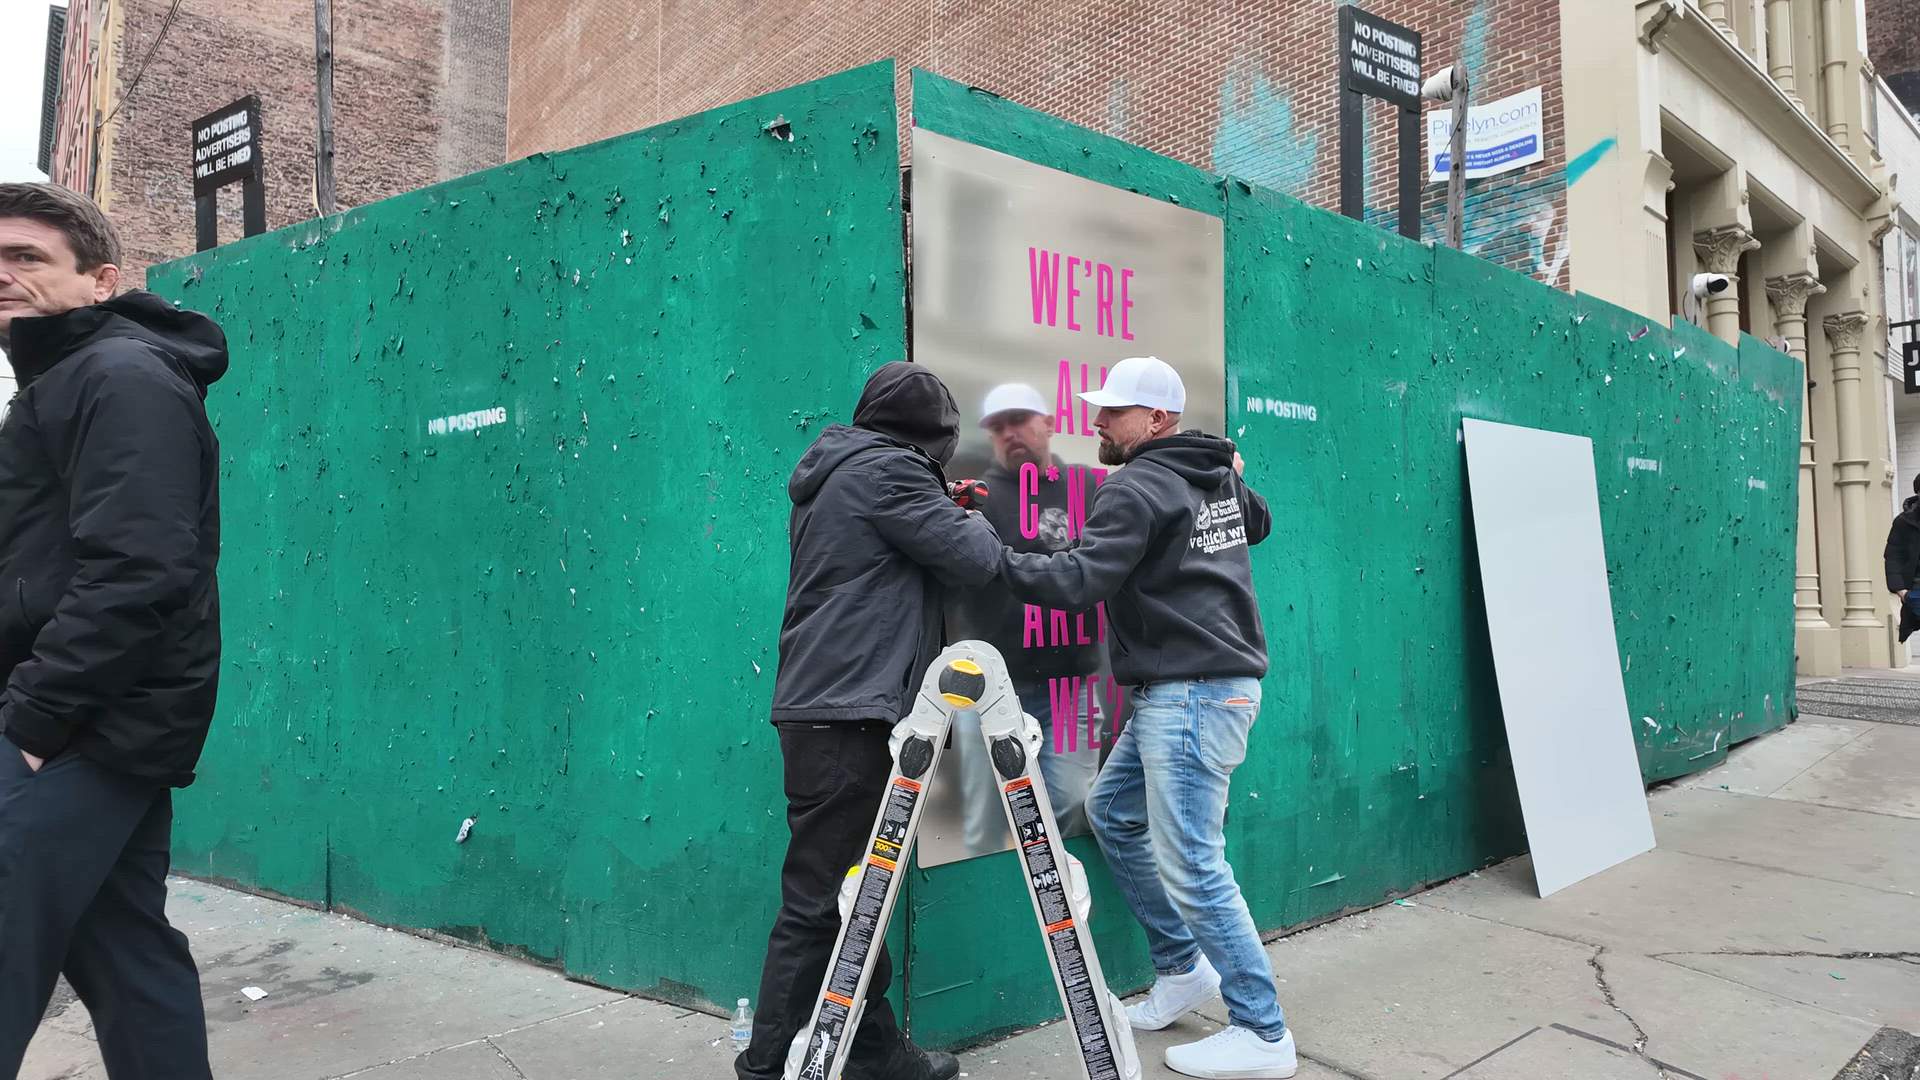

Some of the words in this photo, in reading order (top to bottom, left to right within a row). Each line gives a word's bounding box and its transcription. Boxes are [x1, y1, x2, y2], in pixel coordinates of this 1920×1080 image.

[1354, 21, 1371, 39] NO
[1372, 28, 1417, 58] POSTING
[1351, 38, 1420, 79] ADVERTISERS
[1351, 58, 1376, 79] WILL
[1377, 68, 1390, 86] BE
[1391, 75, 1419, 96] FINED
[198, 127, 211, 143] NO
[211, 110, 248, 138] POSTING
[1433, 102, 1538, 138] Pielyn.com
[195, 126, 251, 162] ADVERTISERS
[196, 162, 215, 179] WILL
[216, 157, 227, 172] BE
[227, 145, 252, 168] FINED
[1028, 247, 1135, 341] WE'RE
[1055, 360, 1109, 437] AL
[1246, 396, 1264, 414] NO
[1265, 398, 1317, 422] POSTING
[428, 418, 447, 435] NO
[447, 406, 507, 433] POSTING
[1190, 527, 1227, 549] vehicle
[1048, 675, 1124, 755] WE?
